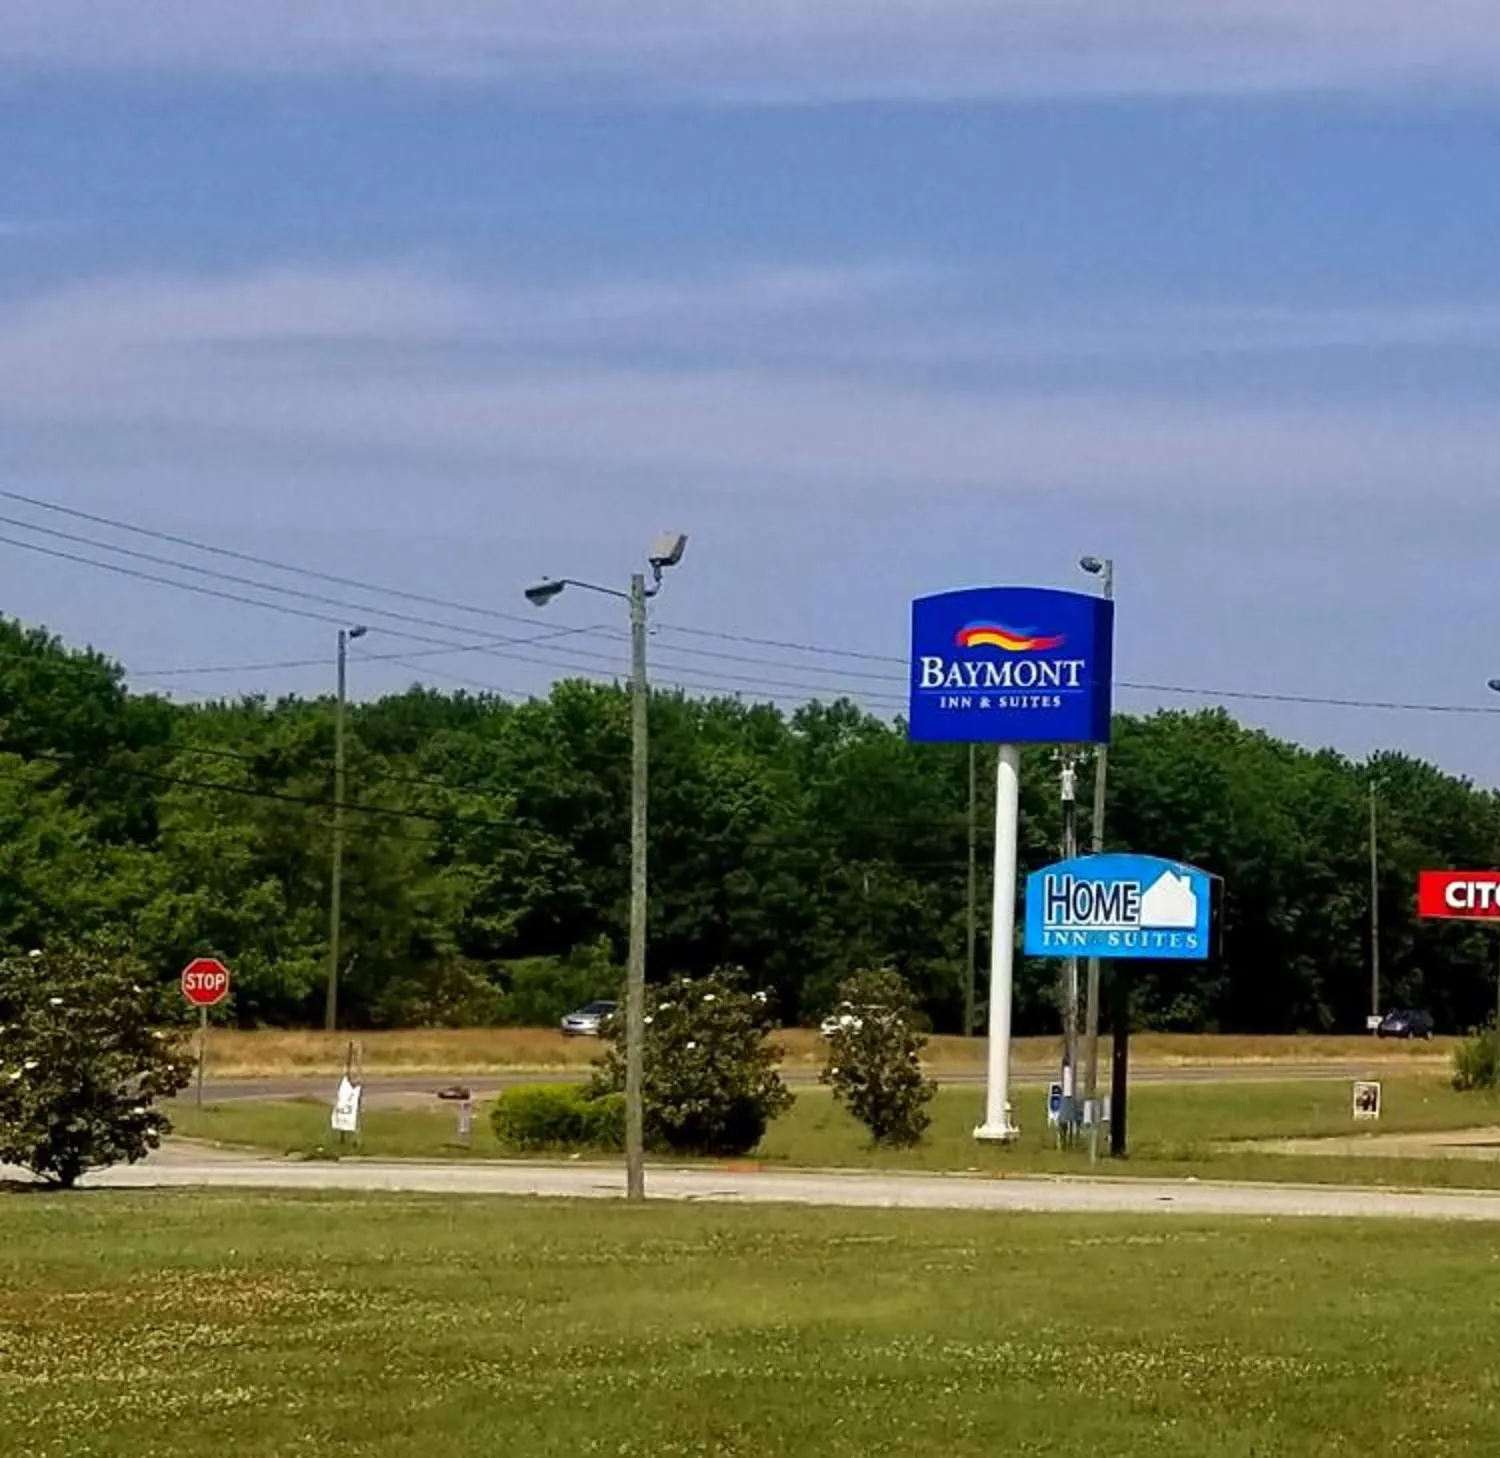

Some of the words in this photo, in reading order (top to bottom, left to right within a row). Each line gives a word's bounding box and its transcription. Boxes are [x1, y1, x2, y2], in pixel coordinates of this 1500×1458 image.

[919, 656, 1085, 688] BAYMONT
[940, 695, 972, 708] INN
[979, 695, 992, 708] &
[999, 695, 1062, 708] SUITES
[1045, 874, 1140, 924] HOME
[1043, 931, 1089, 946] INN
[1108, 931, 1199, 948] SUITES
[185, 973, 225, 990] STOP
